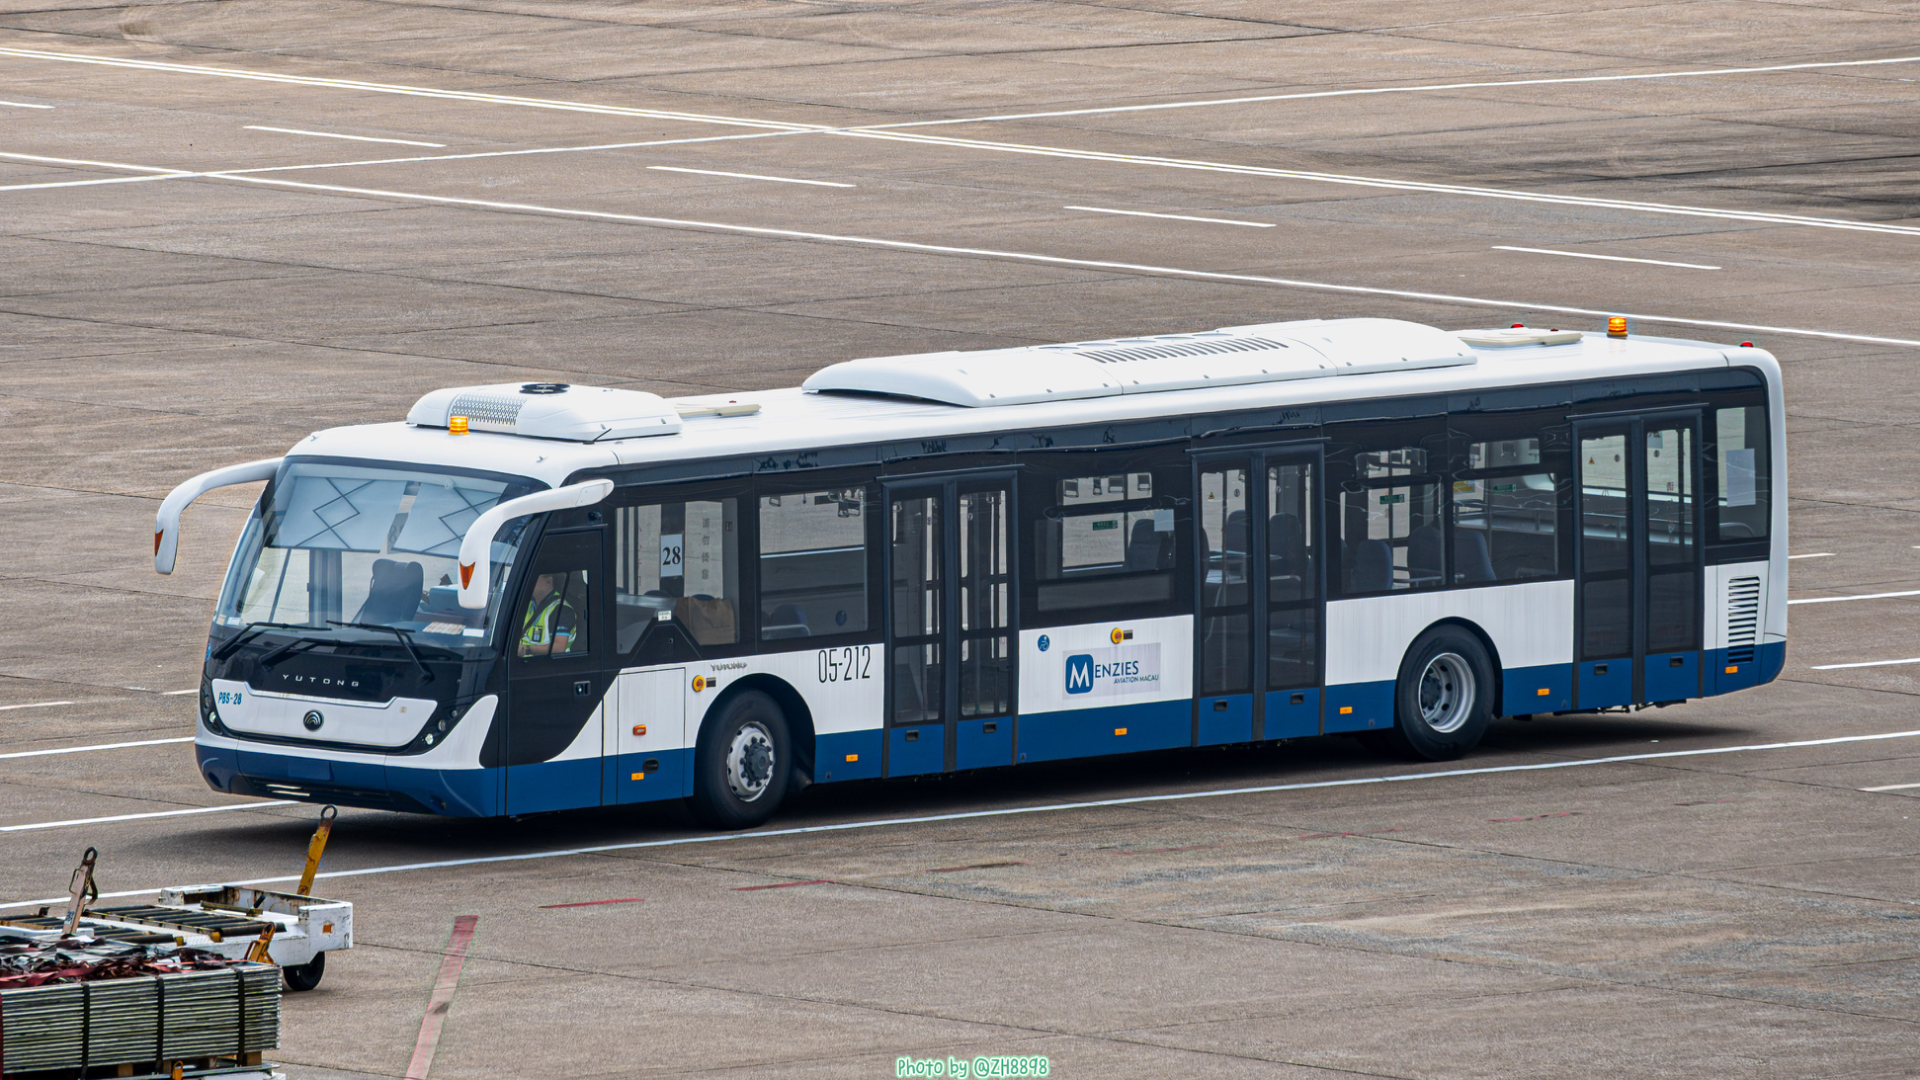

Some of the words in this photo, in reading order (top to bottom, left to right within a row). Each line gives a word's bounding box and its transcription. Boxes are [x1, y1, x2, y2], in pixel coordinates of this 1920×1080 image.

[662, 546, 681, 565] 28
[818, 646, 871, 683] 05-212
[282, 674, 359, 687] YUTONG
[1068, 660, 1139, 689] MENZIES
[1113, 676, 1138, 685] AVIATION
[1139, 674, 1159, 682] MACAU
[217, 691, 242, 705] PBS-28
